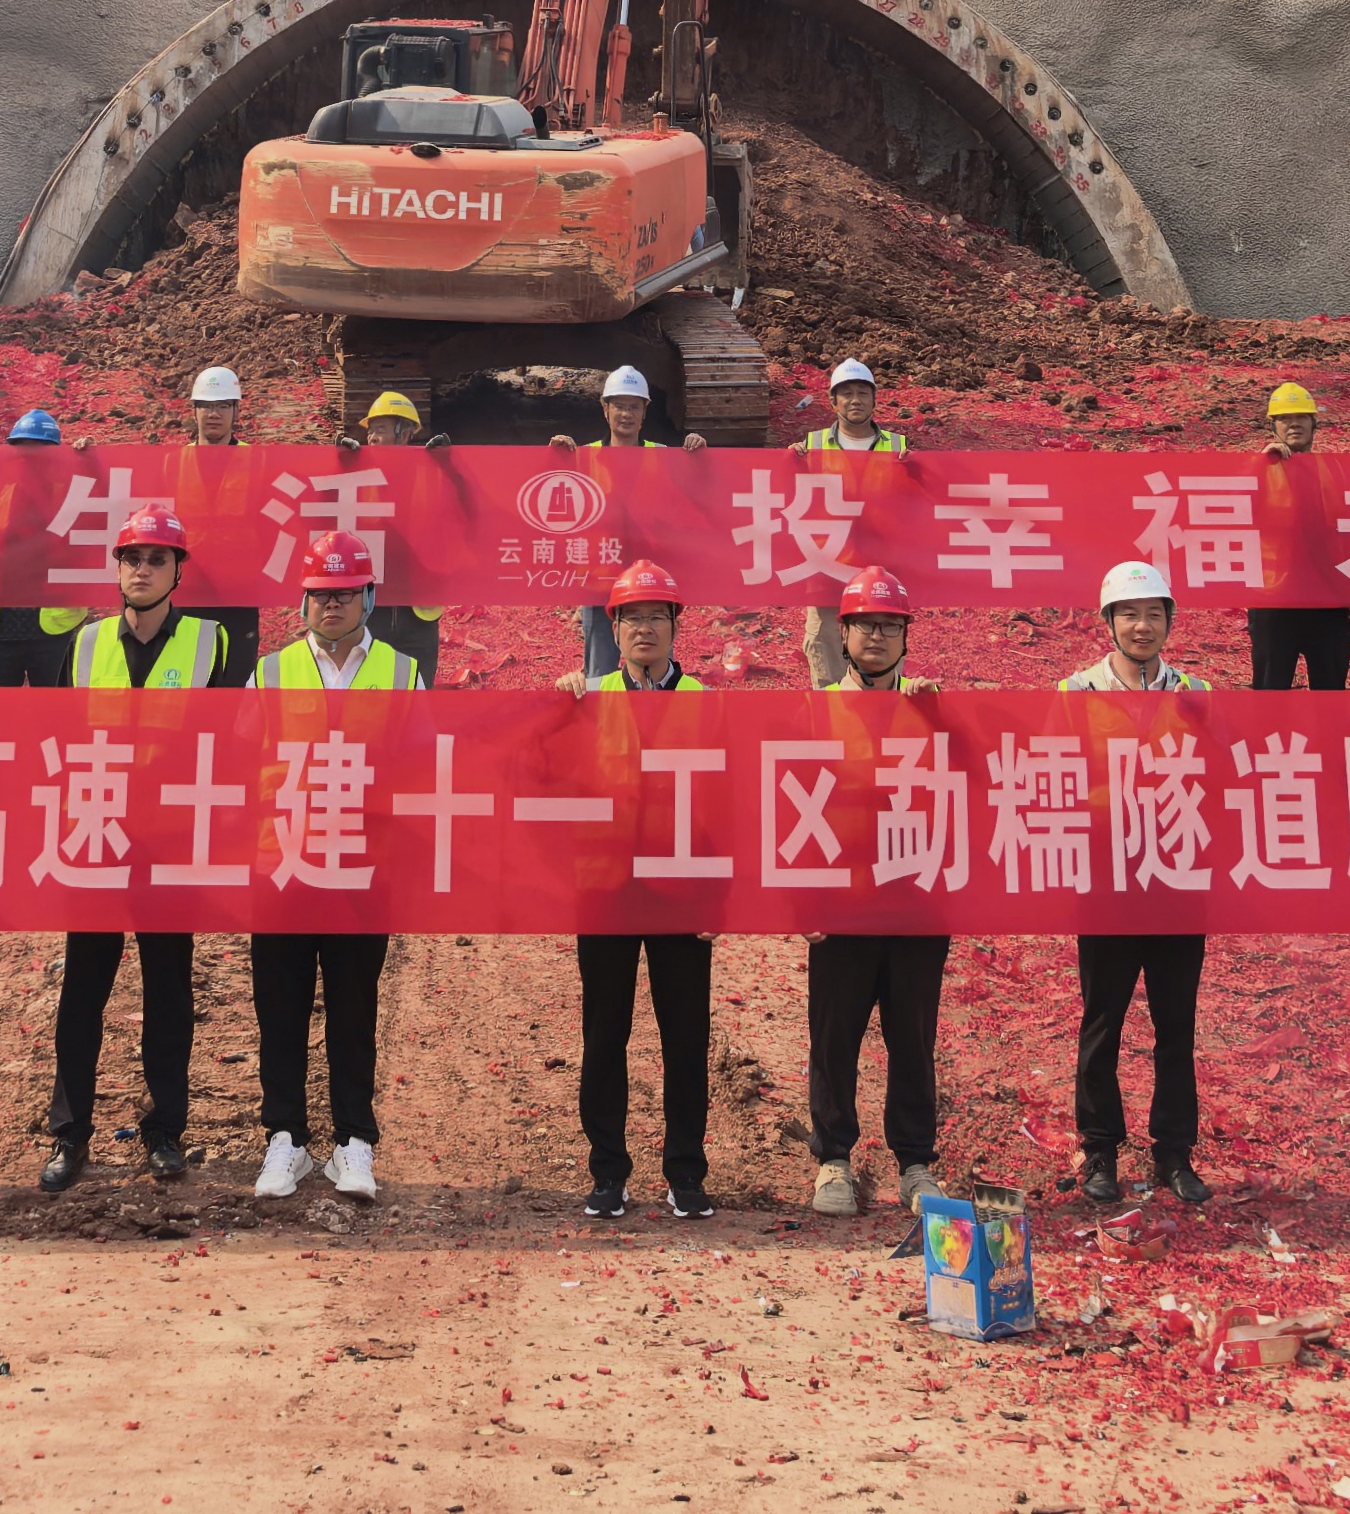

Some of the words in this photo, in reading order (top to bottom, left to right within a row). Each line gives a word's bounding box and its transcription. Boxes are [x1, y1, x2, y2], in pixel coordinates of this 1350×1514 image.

[294, 1, 305, 14] 8
[267, 16, 277, 30] 7
[240, 36, 251, 49] 6
[329, 185, 504, 222] HITACHI
[498, 537, 623, 566] 云南建投
[525, 569, 589, 588] YCIH
